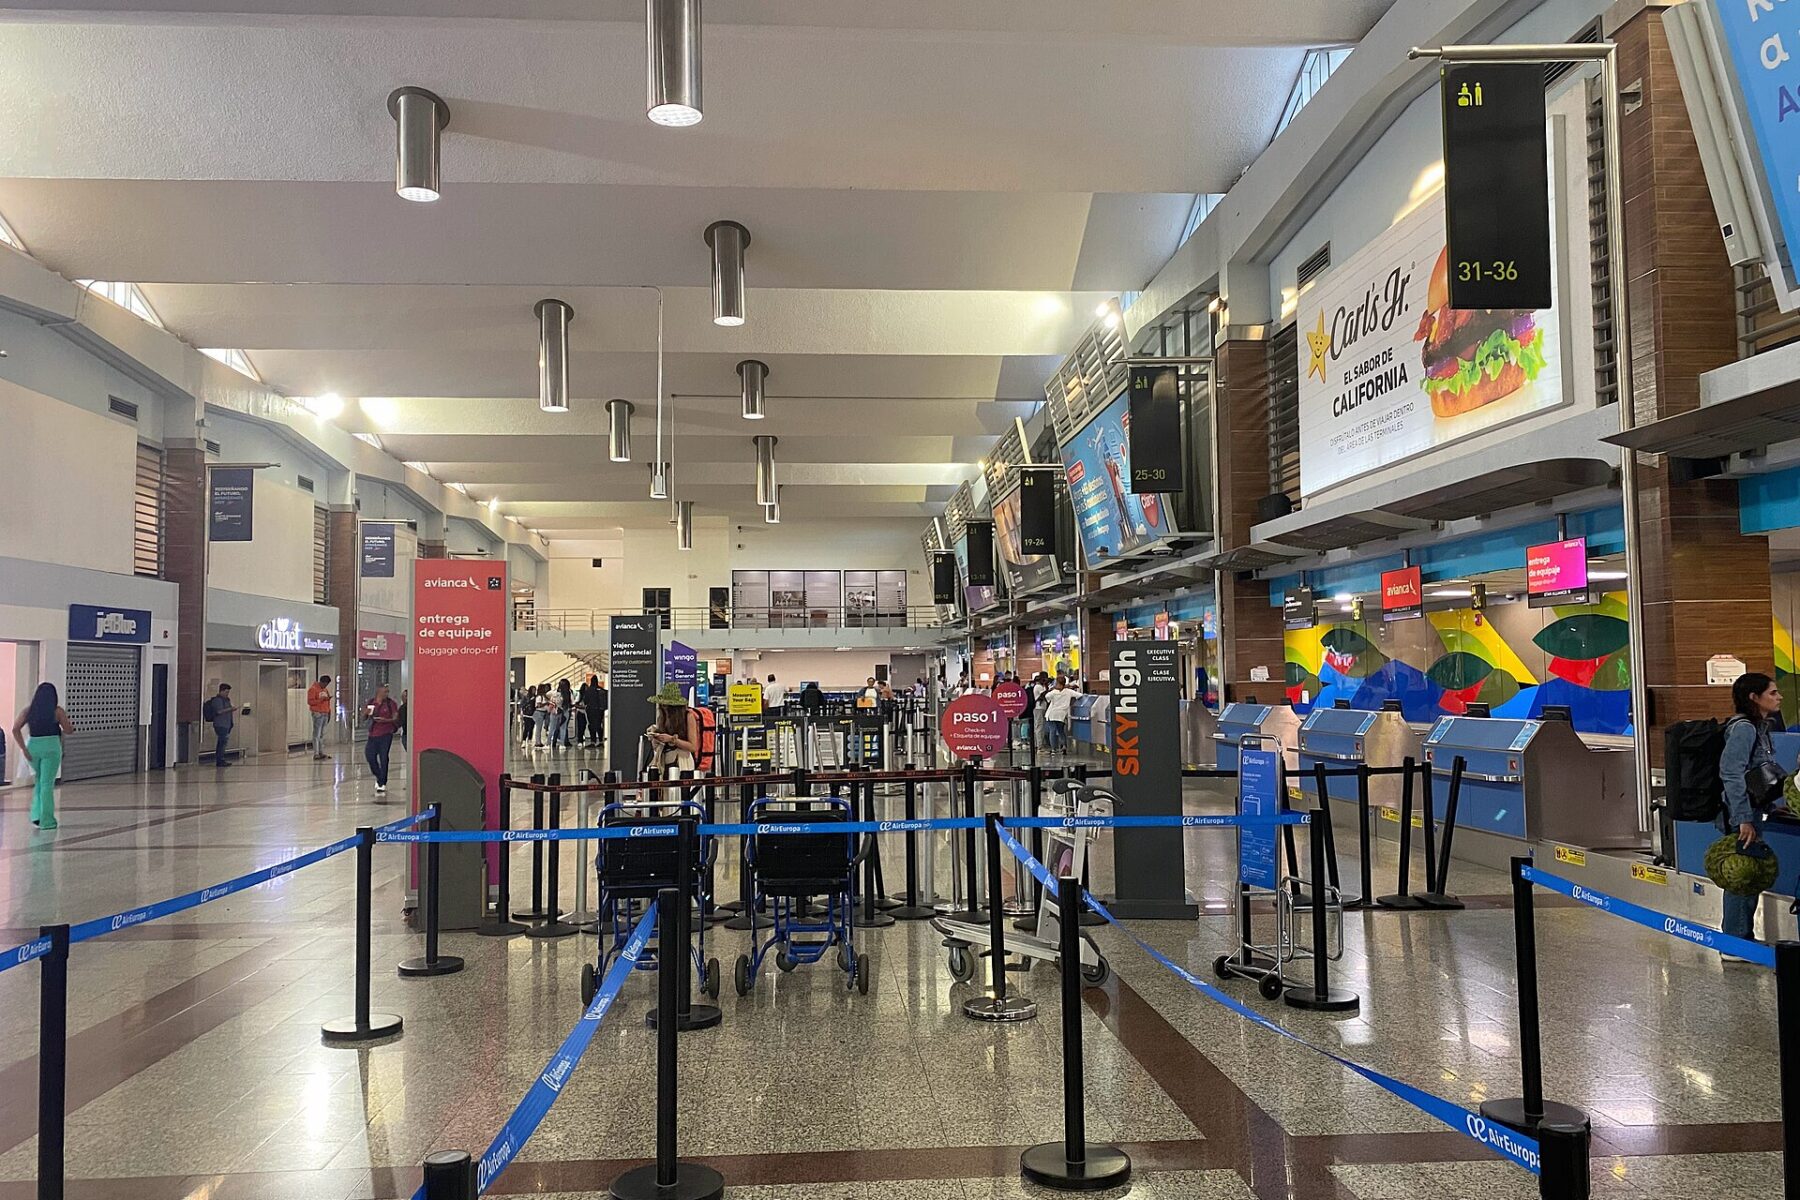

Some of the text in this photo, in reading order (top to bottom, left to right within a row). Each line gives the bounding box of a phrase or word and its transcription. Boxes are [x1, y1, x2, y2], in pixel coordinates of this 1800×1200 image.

[1457, 262, 1518, 282] 31-36
[1330, 266, 1410, 360] Carl's Jr.
[1343, 347, 1393, 385] EL SABOR DE
[1333, 362, 1408, 418] CALIFORNIA
[1393, 402, 1415, 419] DENTRO
[1374, 420, 1404, 440] TERMINALES
[1135, 469, 1166, 480] 25-30
[1024, 538, 1045, 546] 19-24
[1528, 556, 1551, 566] entrega
[1528, 565, 1561, 578] de equipaje
[424, 577, 468, 588] avianca
[1386, 583, 1410, 597] avianca
[419, 614, 470, 626] entrega
[258, 618, 301, 650] Cabinet
[419, 627, 492, 640] de equipaje
[418, 645, 498, 656] baggage drop-off
[612, 642, 635, 650] viajero
[612, 649, 652, 657] preferencial
[997, 691, 1017, 699] paso
[953, 712, 989, 725] paso
[991, 711, 997, 722] 1
[891, 822, 923, 831] AirEuropa
[1075, 819, 1105, 827] AirEuropa
[1194, 817, 1225, 825] AirEuropa
[643, 826, 675, 836] AirEuropa
[770, 824, 801, 833] AirEuropa
[515, 832, 548, 840] AirEuropa
[1581, 889, 1603, 906] AirEuropa
[121, 911, 147, 925] AirEuropa
[1675, 924, 1704, 941] AirEuropa
[487, 1141, 511, 1178] AirEuropa
